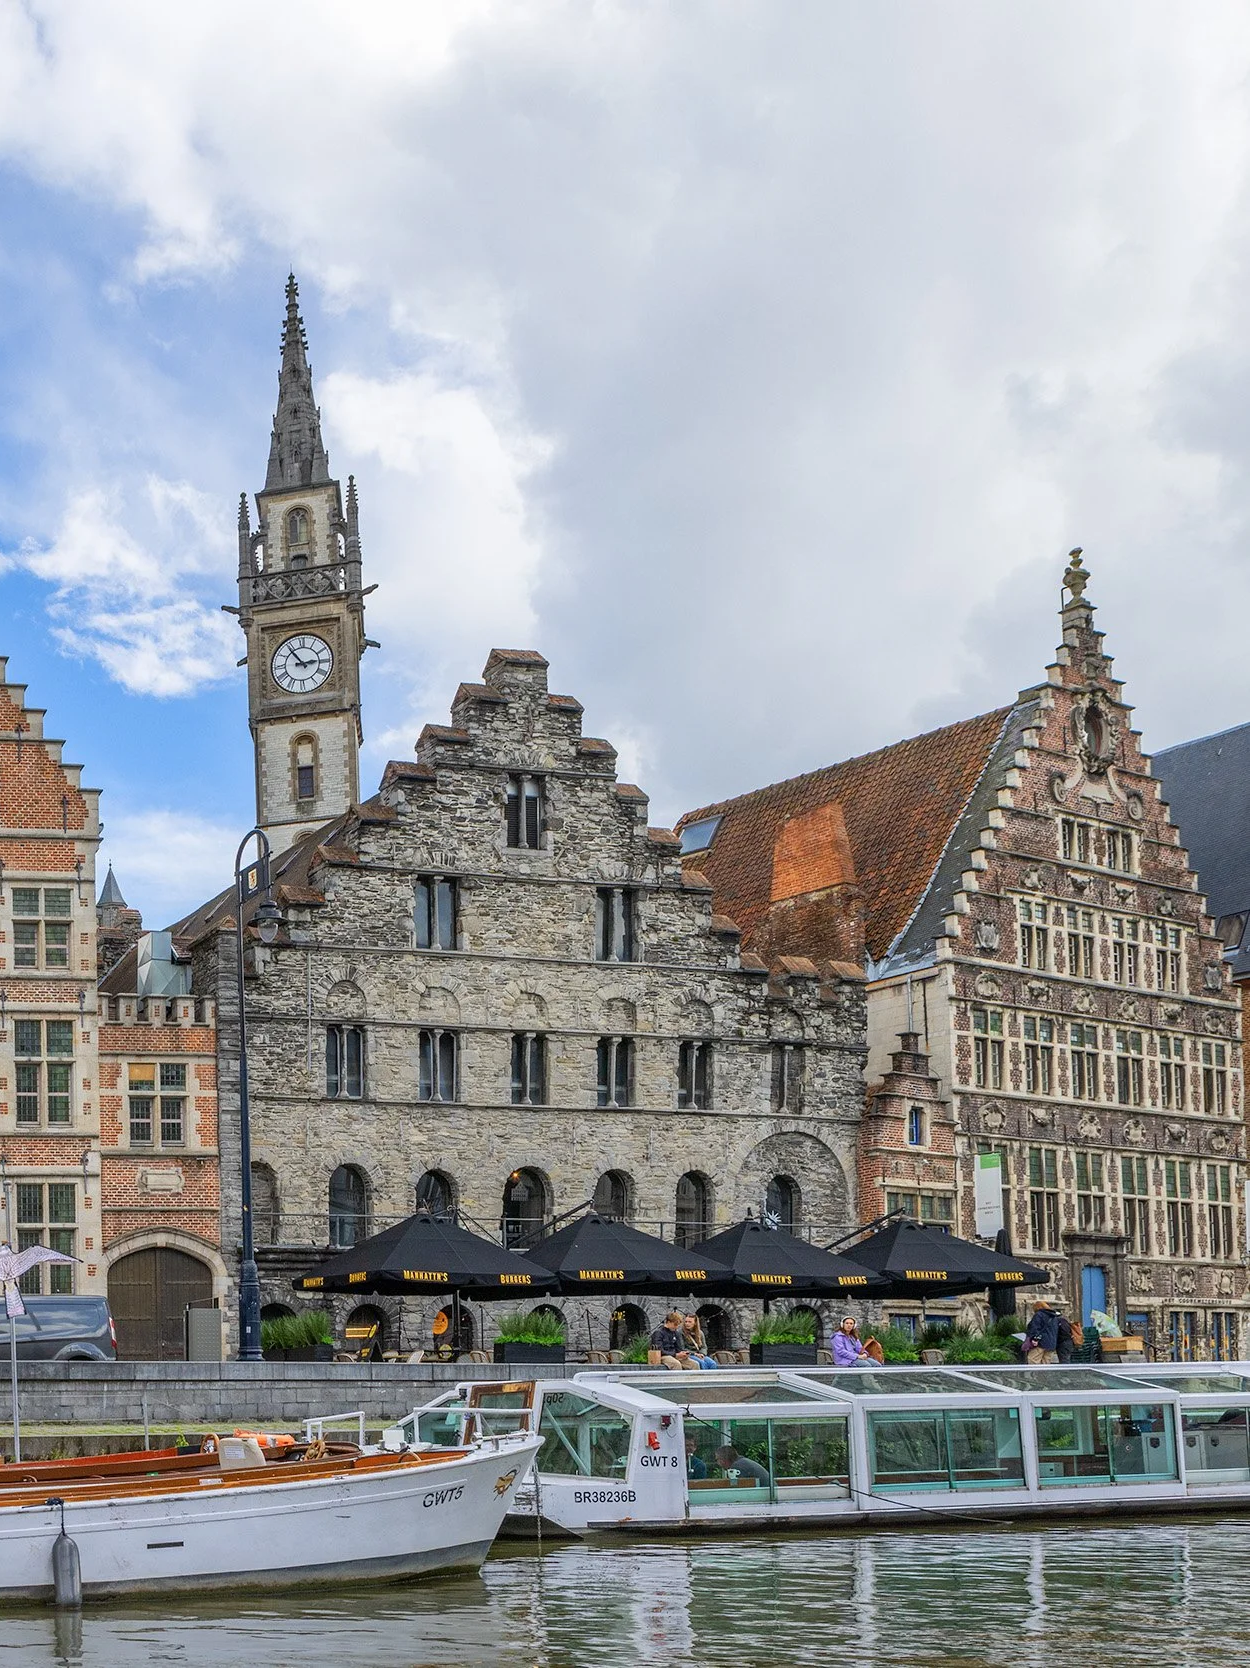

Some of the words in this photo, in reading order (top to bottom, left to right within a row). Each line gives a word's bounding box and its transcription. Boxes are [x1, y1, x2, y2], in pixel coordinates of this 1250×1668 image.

[500, 1274, 532, 1284] BURGERS
[675, 1270, 707, 1280] BURGERS
[995, 1272, 1024, 1281] BURGERS
[838, 1276, 868, 1285] BURGERS
[640, 1455, 668, 1468] GWT
[671, 1456, 679, 1468] 8
[574, 1490, 637, 1503] BR38236B
